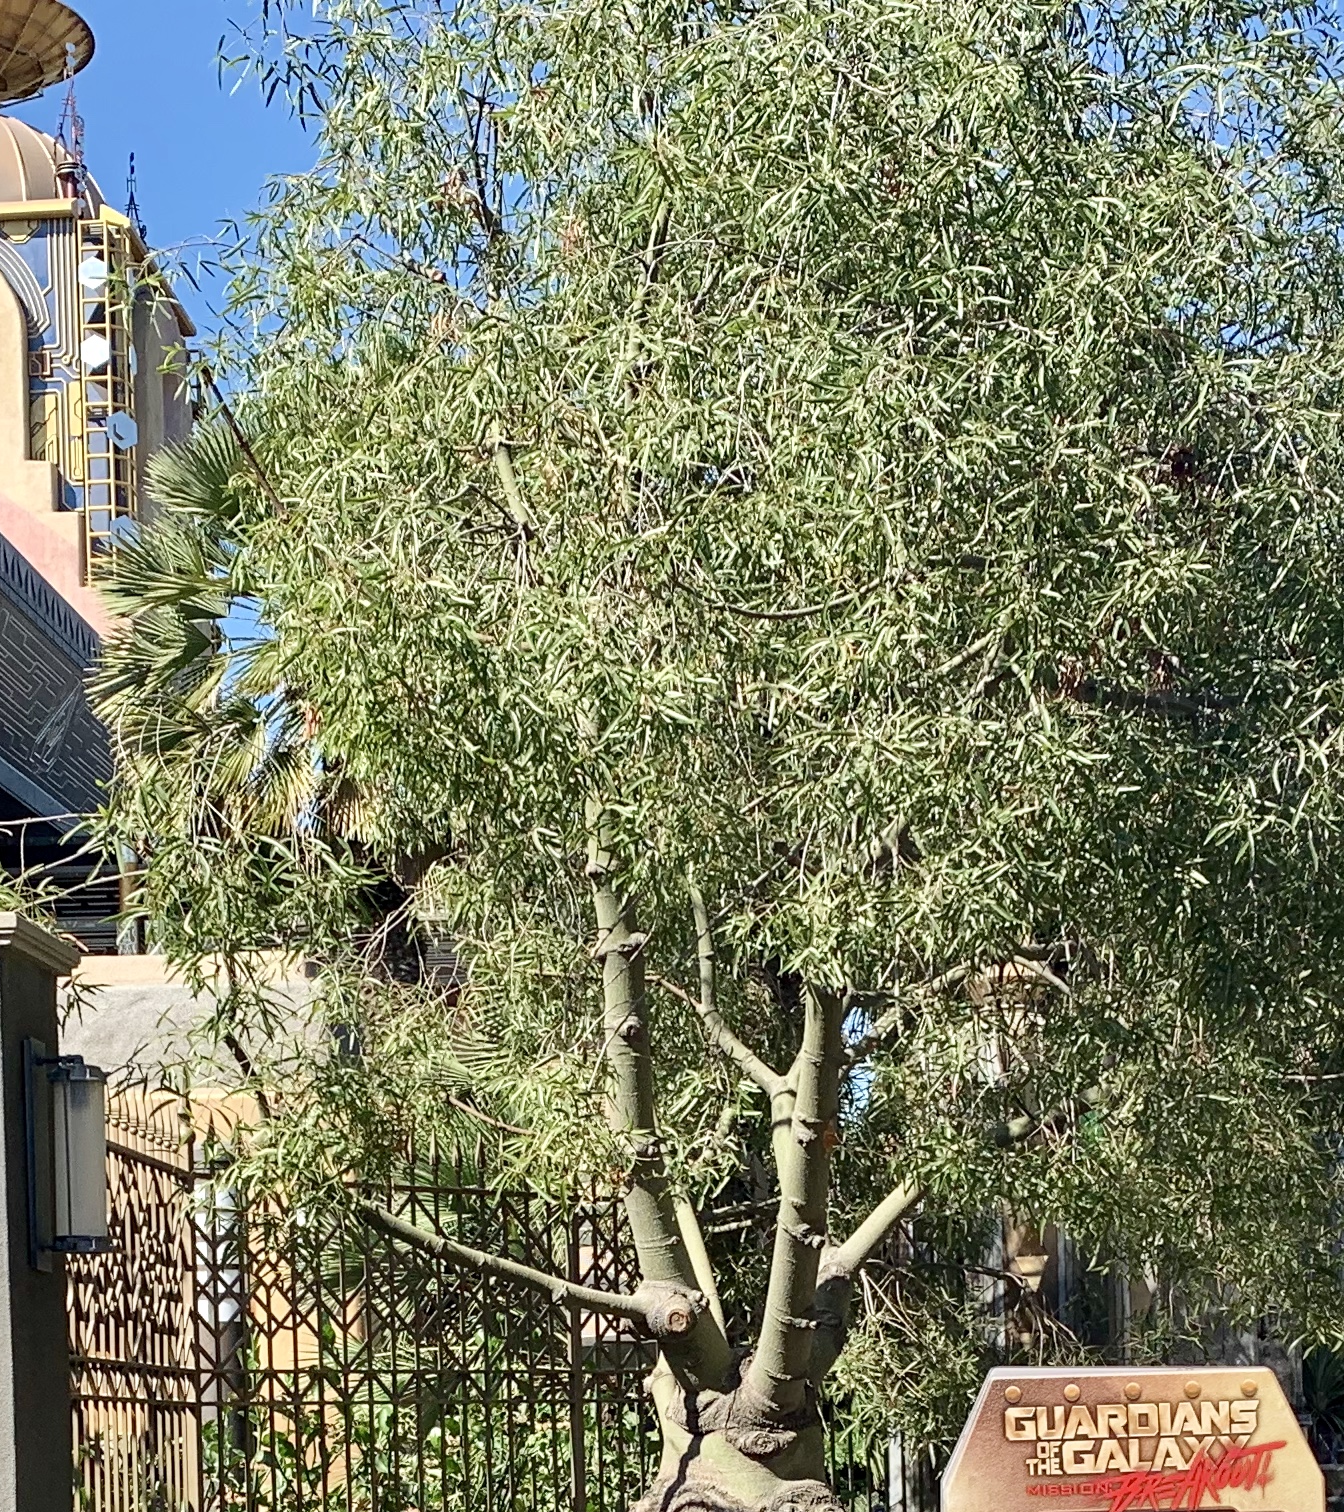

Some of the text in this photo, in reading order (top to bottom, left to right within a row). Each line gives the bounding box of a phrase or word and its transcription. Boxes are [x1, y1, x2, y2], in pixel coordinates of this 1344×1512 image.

[1004, 1399, 1260, 1441] GUARDIANS
[1026, 1435, 1251, 1476] THE GALAXY
[1036, 1441, 1061, 1459] OF
